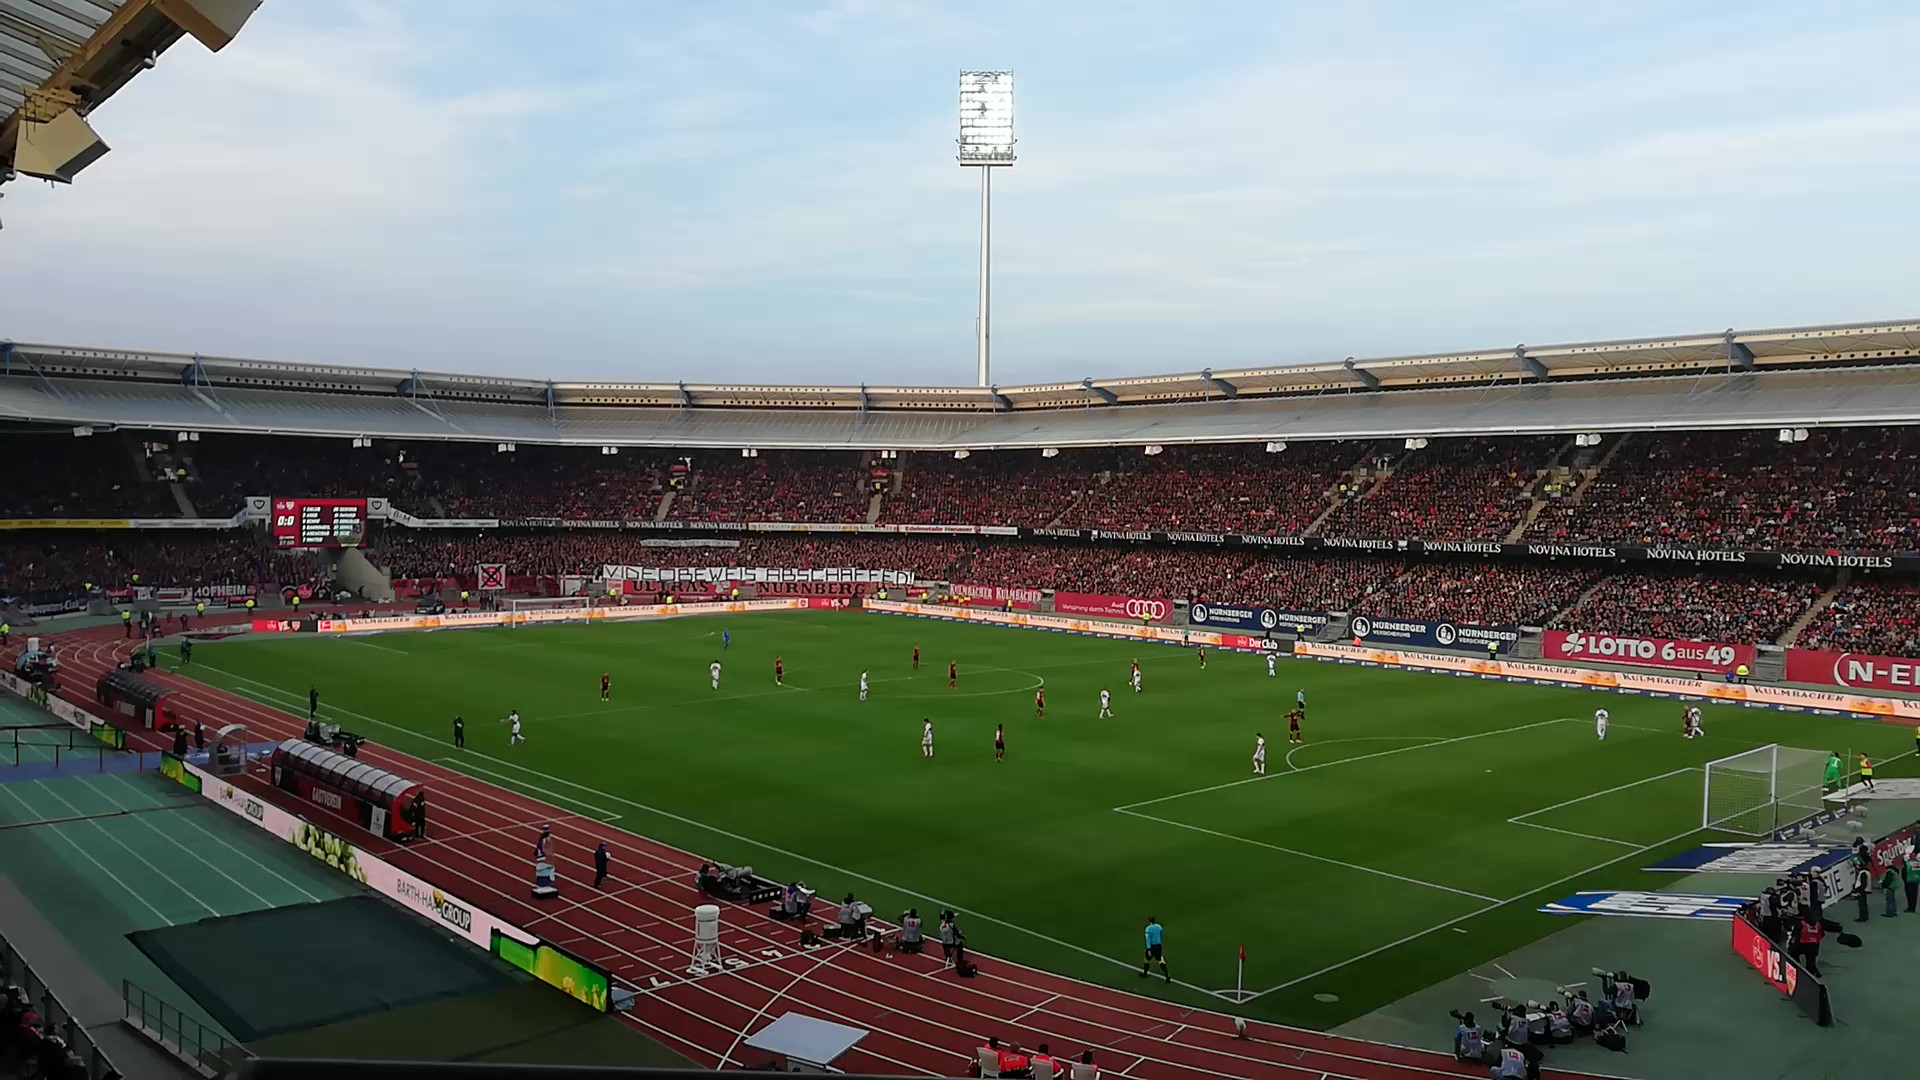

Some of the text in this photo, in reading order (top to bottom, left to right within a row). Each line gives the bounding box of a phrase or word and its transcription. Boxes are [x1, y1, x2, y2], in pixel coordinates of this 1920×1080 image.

[563, 520, 620, 528] NOVINA HOTELS
[626, 521, 683, 529] NOVINA HOTELS
[1033, 528, 1080, 537] NOVINA HOTELS
[1100, 531, 1151, 541] NOVINA HOTELS
[1167, 533, 1224, 543] NOVINA HOTELS
[1242, 536, 1305, 546] NOVINA HOTELS
[1324, 538, 1393, 549] NOVINA HOTELS
[1423, 541, 1501, 553] NOVINA HOTELS
[1528, 545, 1616, 557] NOVINA HOTELS
[1647, 549, 1746, 562] NOVINA HOTELS
[1781, 553, 1892, 567] NOVINA HOTELS
[605, 565, 756, 582] VIDEOBEWEIS
[444, 613, 499, 621] KULMBACHER
[1311, 643, 1368, 654] KULMBACHER
[1589, 636, 1656, 659] LOTTO
[1403, 652, 1467, 664] KULMBACHER
[1506, 662, 1578, 675] KULMBACHER
[1623, 673, 1703, 688] KULMBACHER
[1753, 685, 1844, 702] KULMBACHER
[441, 902, 471, 930] GROUP
[1767, 949, 1783, 981] VS.
